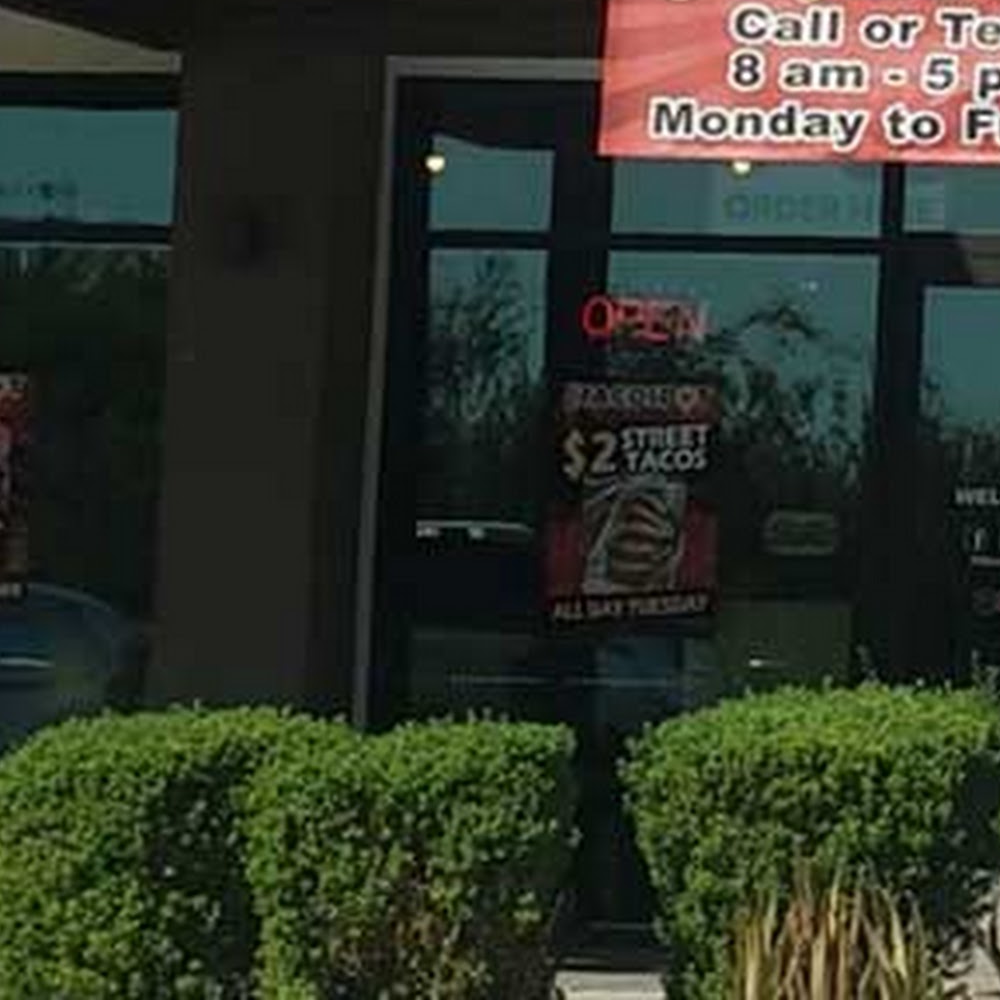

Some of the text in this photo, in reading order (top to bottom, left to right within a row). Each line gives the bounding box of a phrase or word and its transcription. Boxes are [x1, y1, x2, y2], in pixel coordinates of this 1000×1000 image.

[734, 8, 840, 43] Call
[863, 15, 916, 46] or
[730, 53, 762, 88] 8
[784, 60, 865, 90] am
[926, 56, 955, 90] 5
[652, 101, 864, 147] Monday
[887, 107, 941, 143] to
[562, 424, 711, 481] $2 STREET
[624, 450, 708, 472] TACOS
